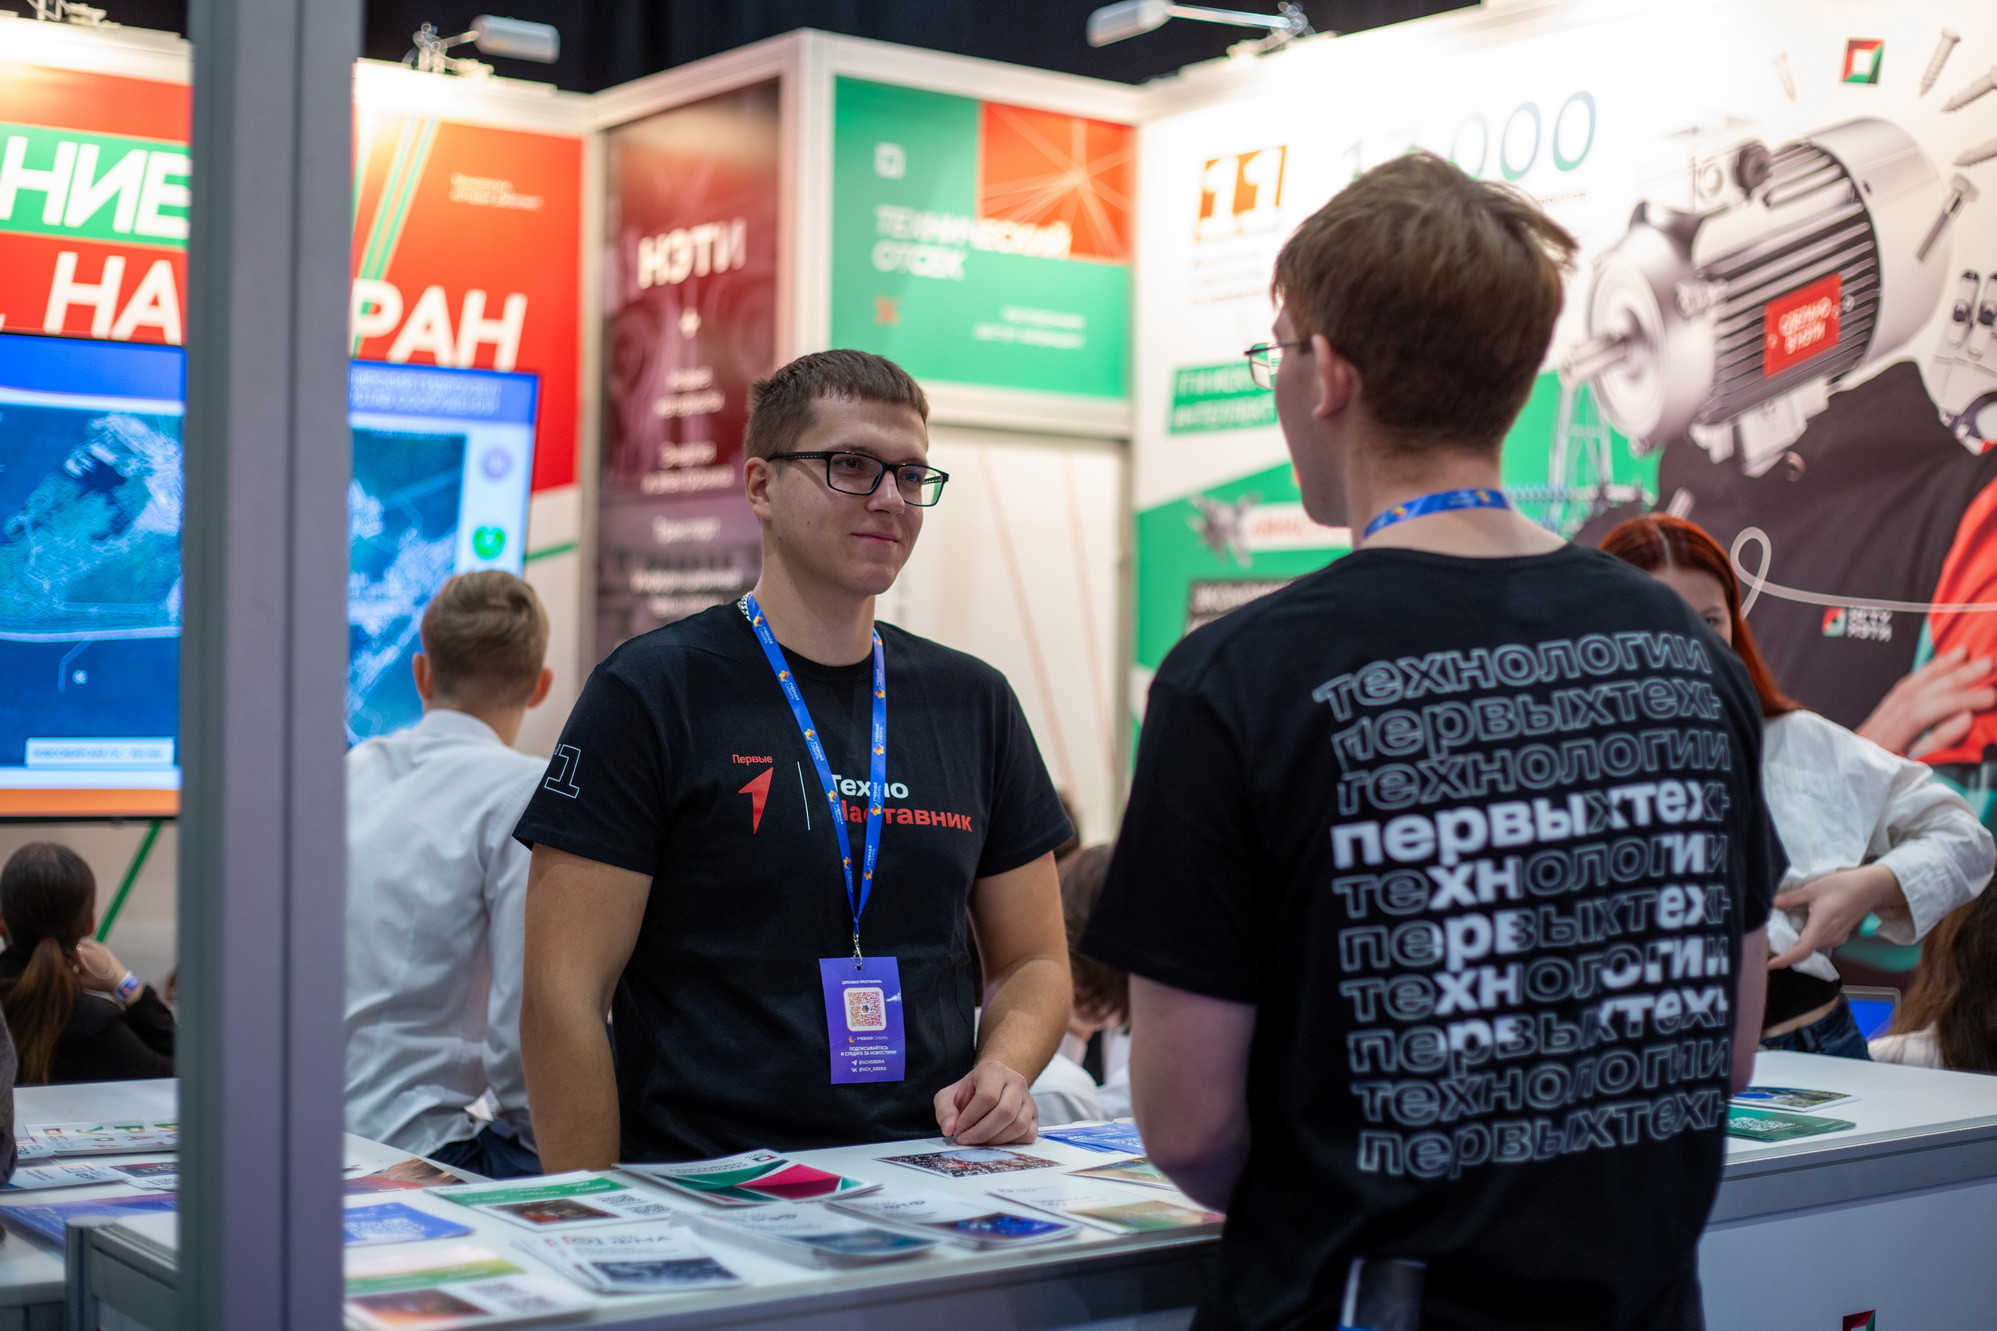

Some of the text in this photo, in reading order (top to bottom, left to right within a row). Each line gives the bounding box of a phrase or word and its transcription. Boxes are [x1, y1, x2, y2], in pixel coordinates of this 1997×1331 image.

[637, 216, 747, 289] НЭТИ
[43, 251, 183, 346] НА
[1313, 631, 1712, 721] технологии
[732, 753, 773, 766] Первые
[1337, 729, 1731, 816] технологии
[1332, 832, 1728, 919] технологии
[1339, 937, 1729, 1022] технологии
[1350, 1038, 1730, 1124] технологии
